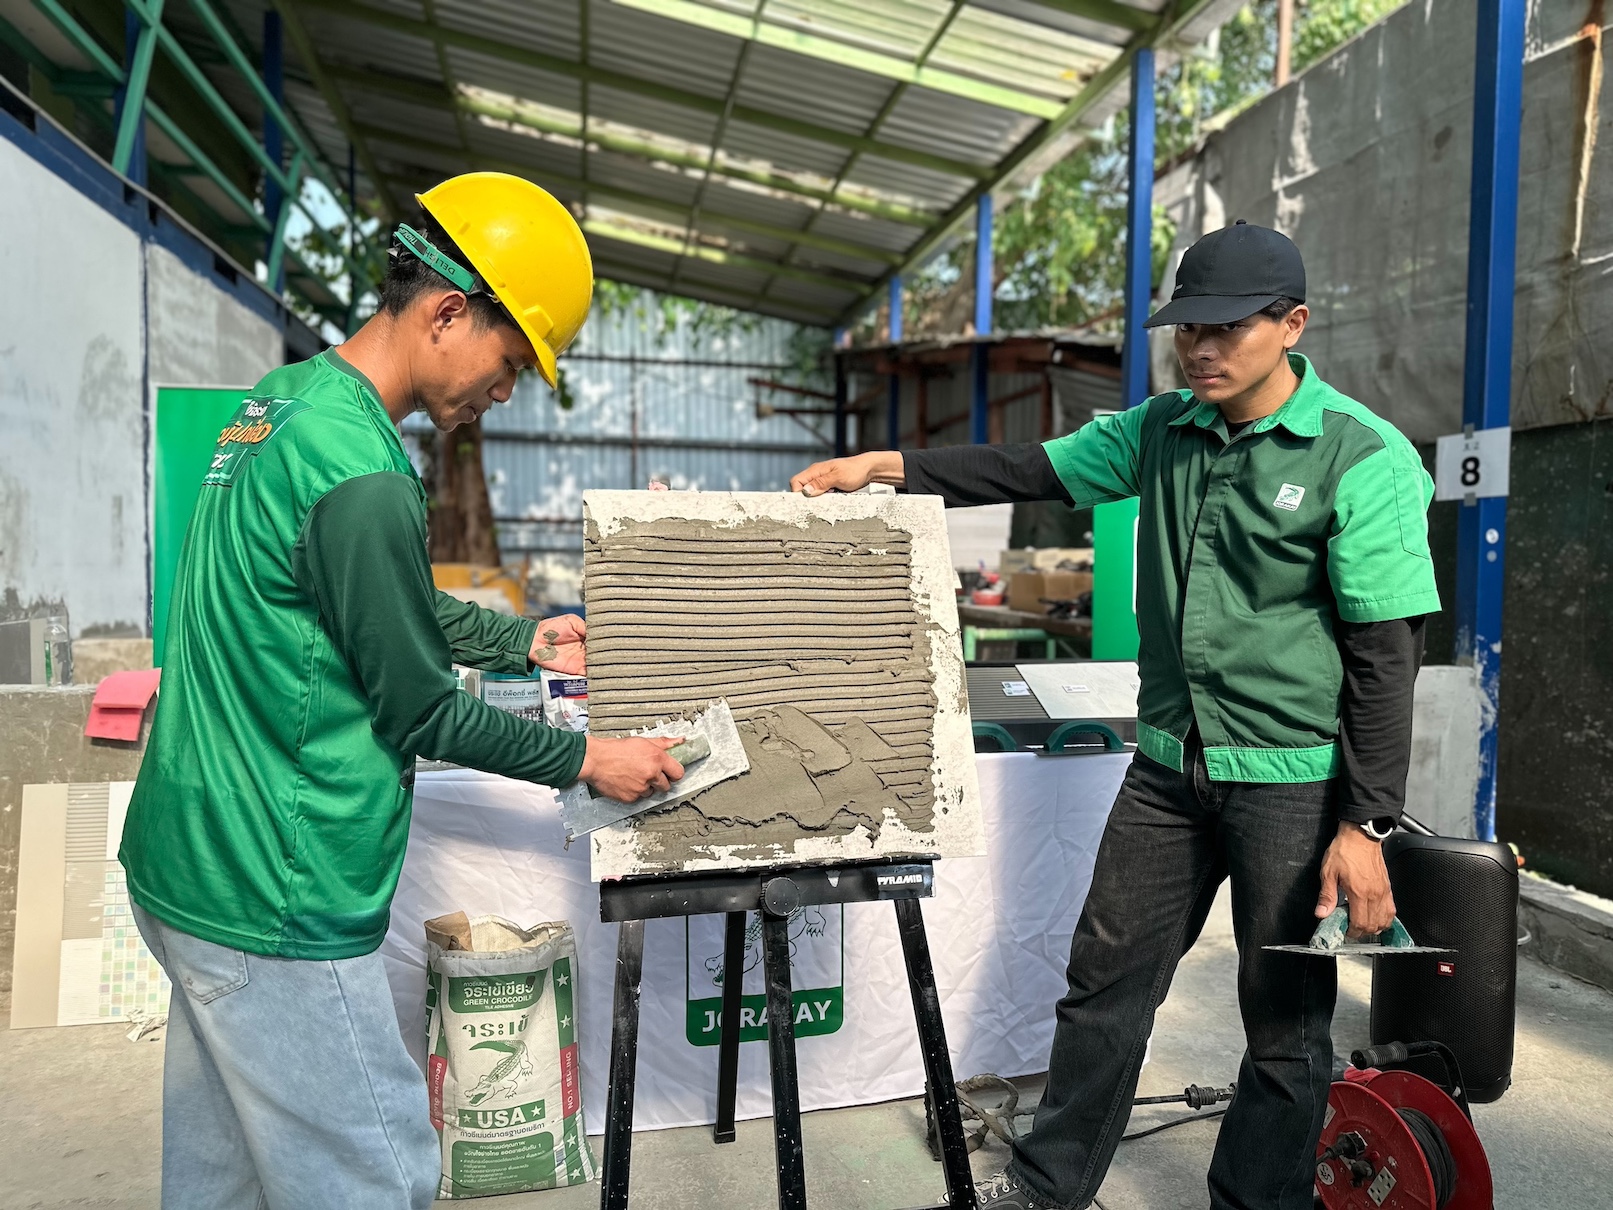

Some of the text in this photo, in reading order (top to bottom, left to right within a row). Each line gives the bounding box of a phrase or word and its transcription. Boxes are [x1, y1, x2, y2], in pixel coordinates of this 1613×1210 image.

[1461, 456, 1480, 487] 8
[877, 874, 923, 886] PYRAMID
[463, 994, 533, 1006] GREEN CROCODILE
[702, 999, 832, 1033] JRAAY
[477, 1106, 527, 1129] USA
